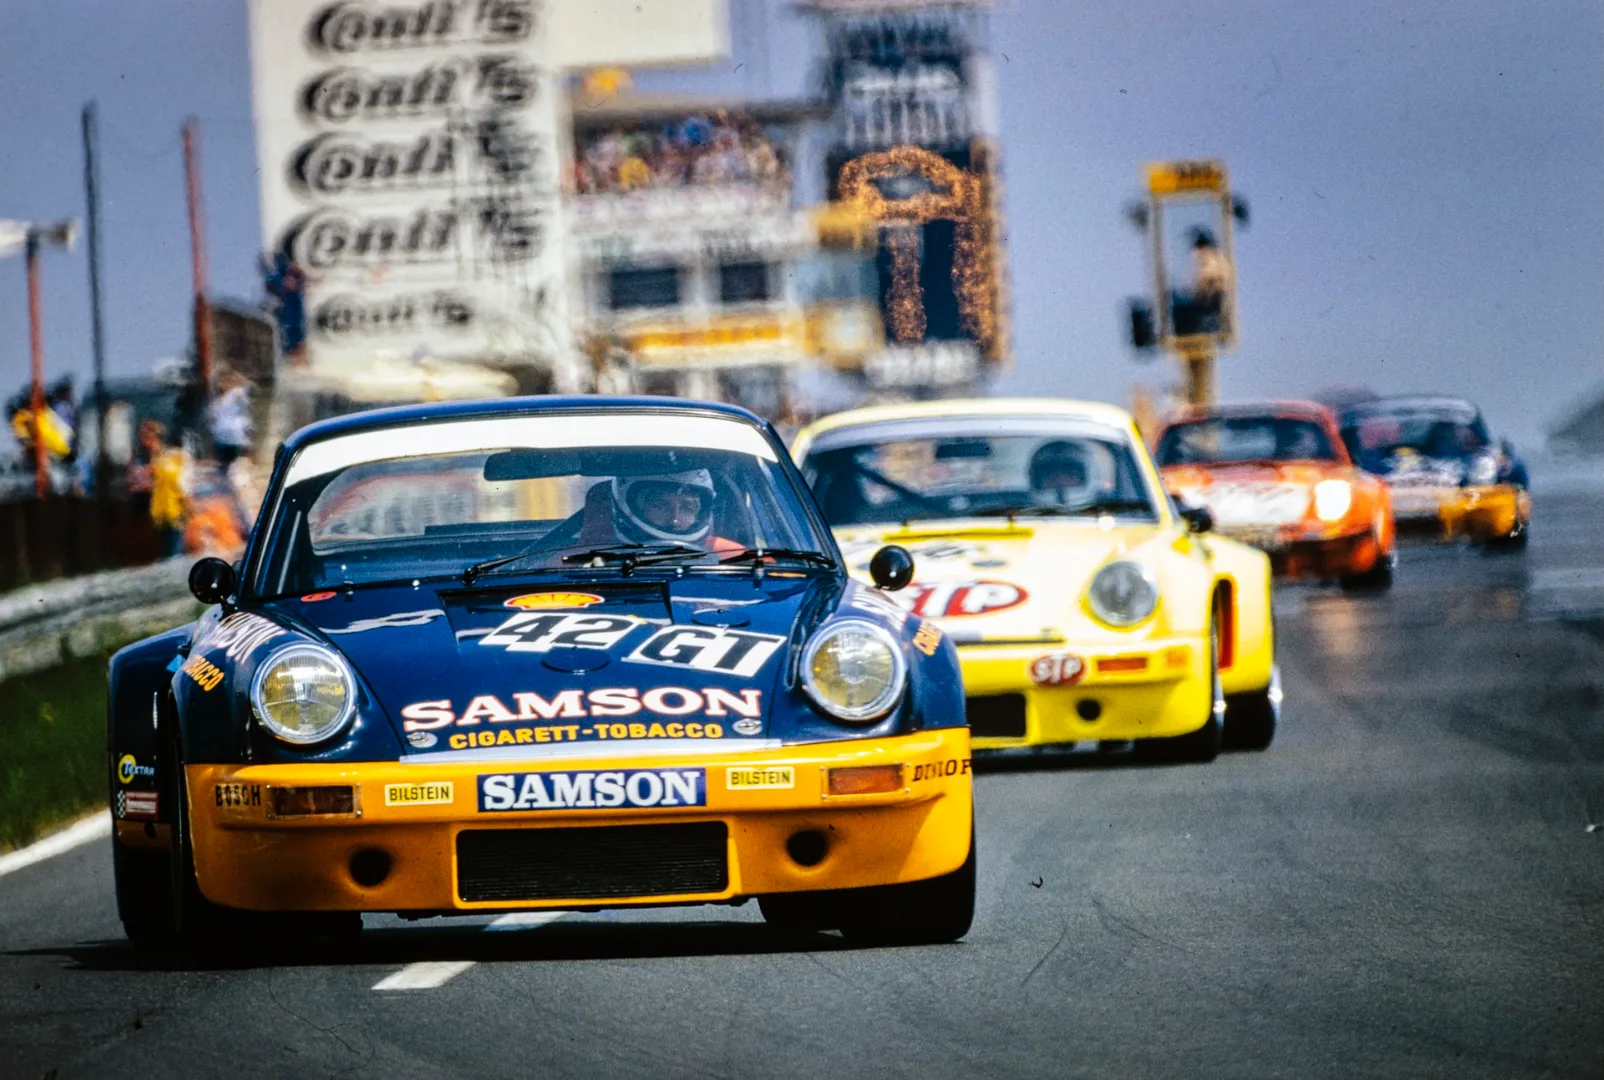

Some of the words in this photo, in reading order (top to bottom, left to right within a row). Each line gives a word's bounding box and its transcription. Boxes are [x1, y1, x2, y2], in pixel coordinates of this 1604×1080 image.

[494, 615, 638, 646] 42
[641, 629, 778, 671] GT
[1034, 654, 1082, 684] STP
[401, 687, 762, 733] SAMSON
[449, 723, 723, 750] CIGARETT-TOBACCO
[483, 771, 699, 810] SAMSON
[731, 771, 791, 785] BILSTEIN
[215, 784, 261, 807] BOSCH
[389, 786, 450, 802] BILSTEIN
